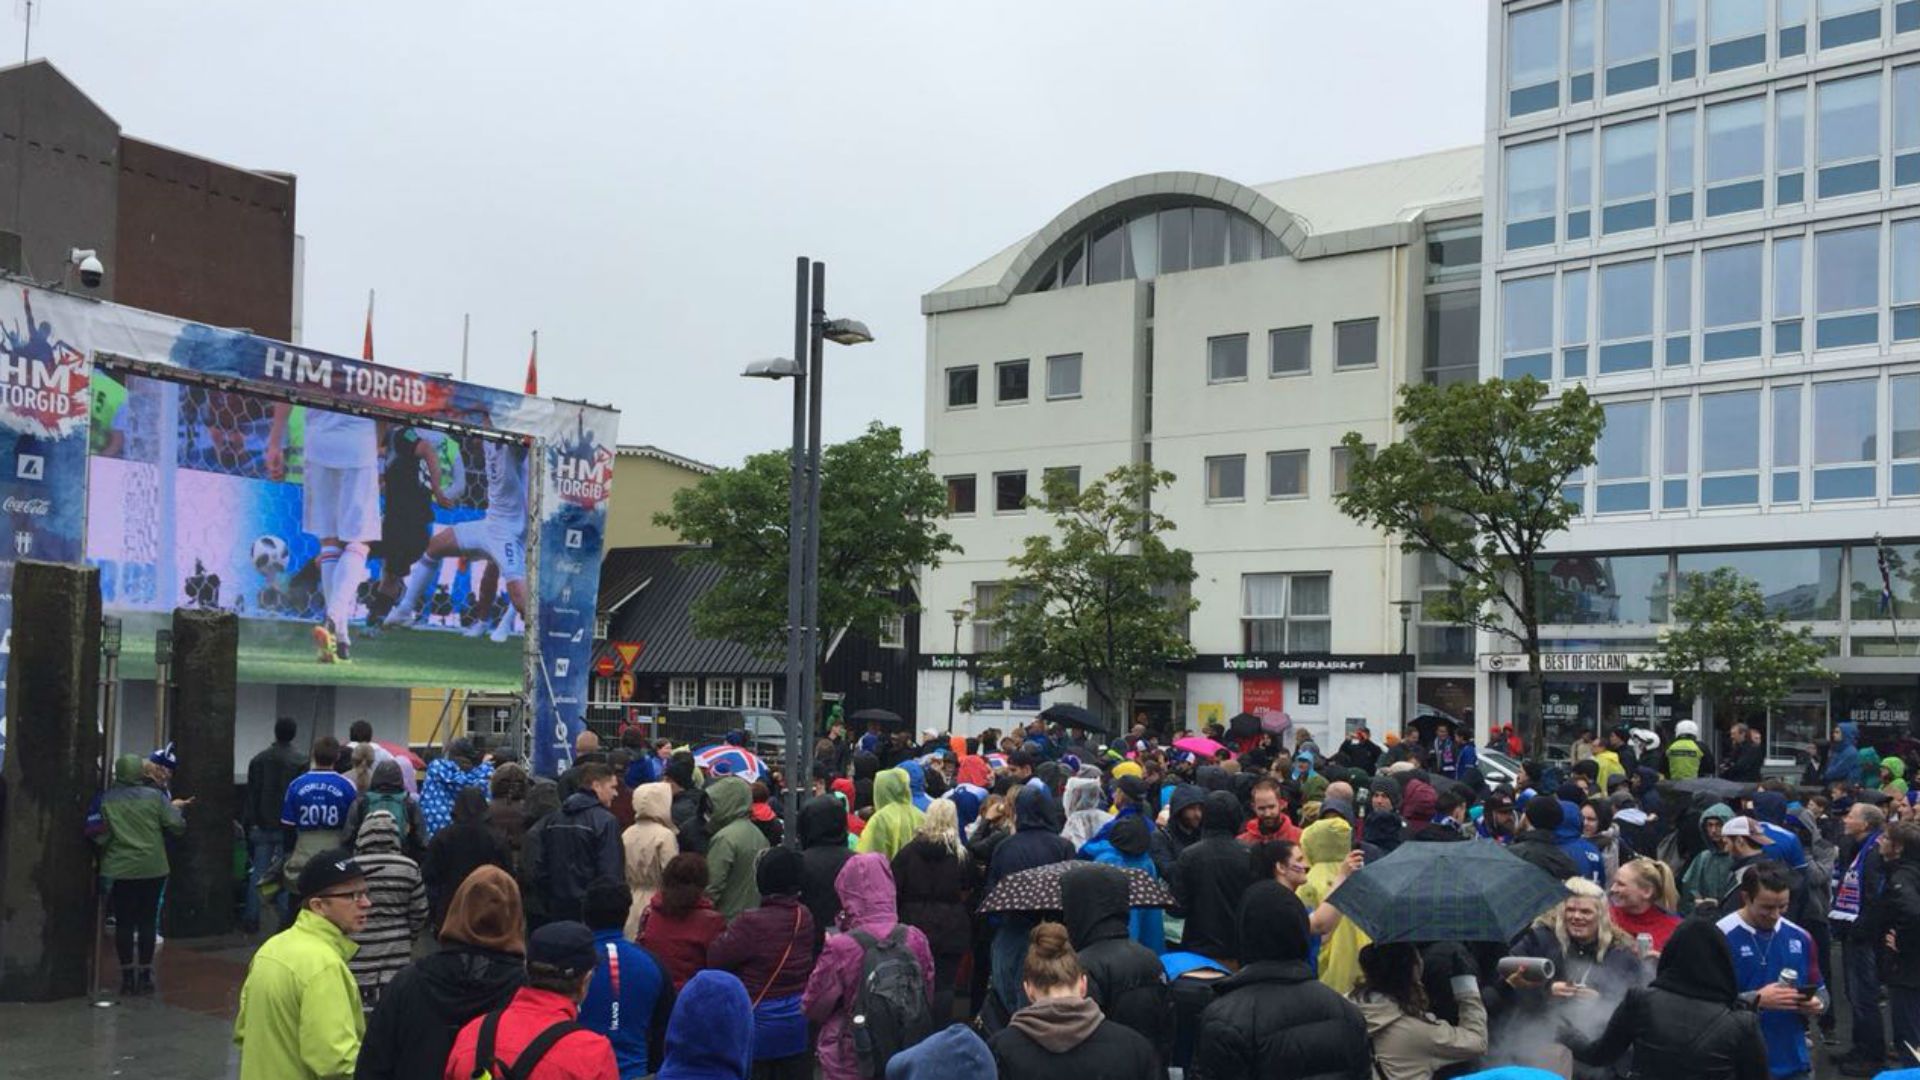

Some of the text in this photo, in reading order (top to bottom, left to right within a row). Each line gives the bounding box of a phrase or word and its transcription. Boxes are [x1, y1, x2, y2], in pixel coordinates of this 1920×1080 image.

[0, 352, 70, 395] HM
[264, 347, 333, 389] HM
[556, 455, 605, 484] HM
[1545, 654, 1628, 670] BEST OF ICELAND
[297, 782, 344, 797] WORLD CUP
[299, 804, 339, 826] 2018
